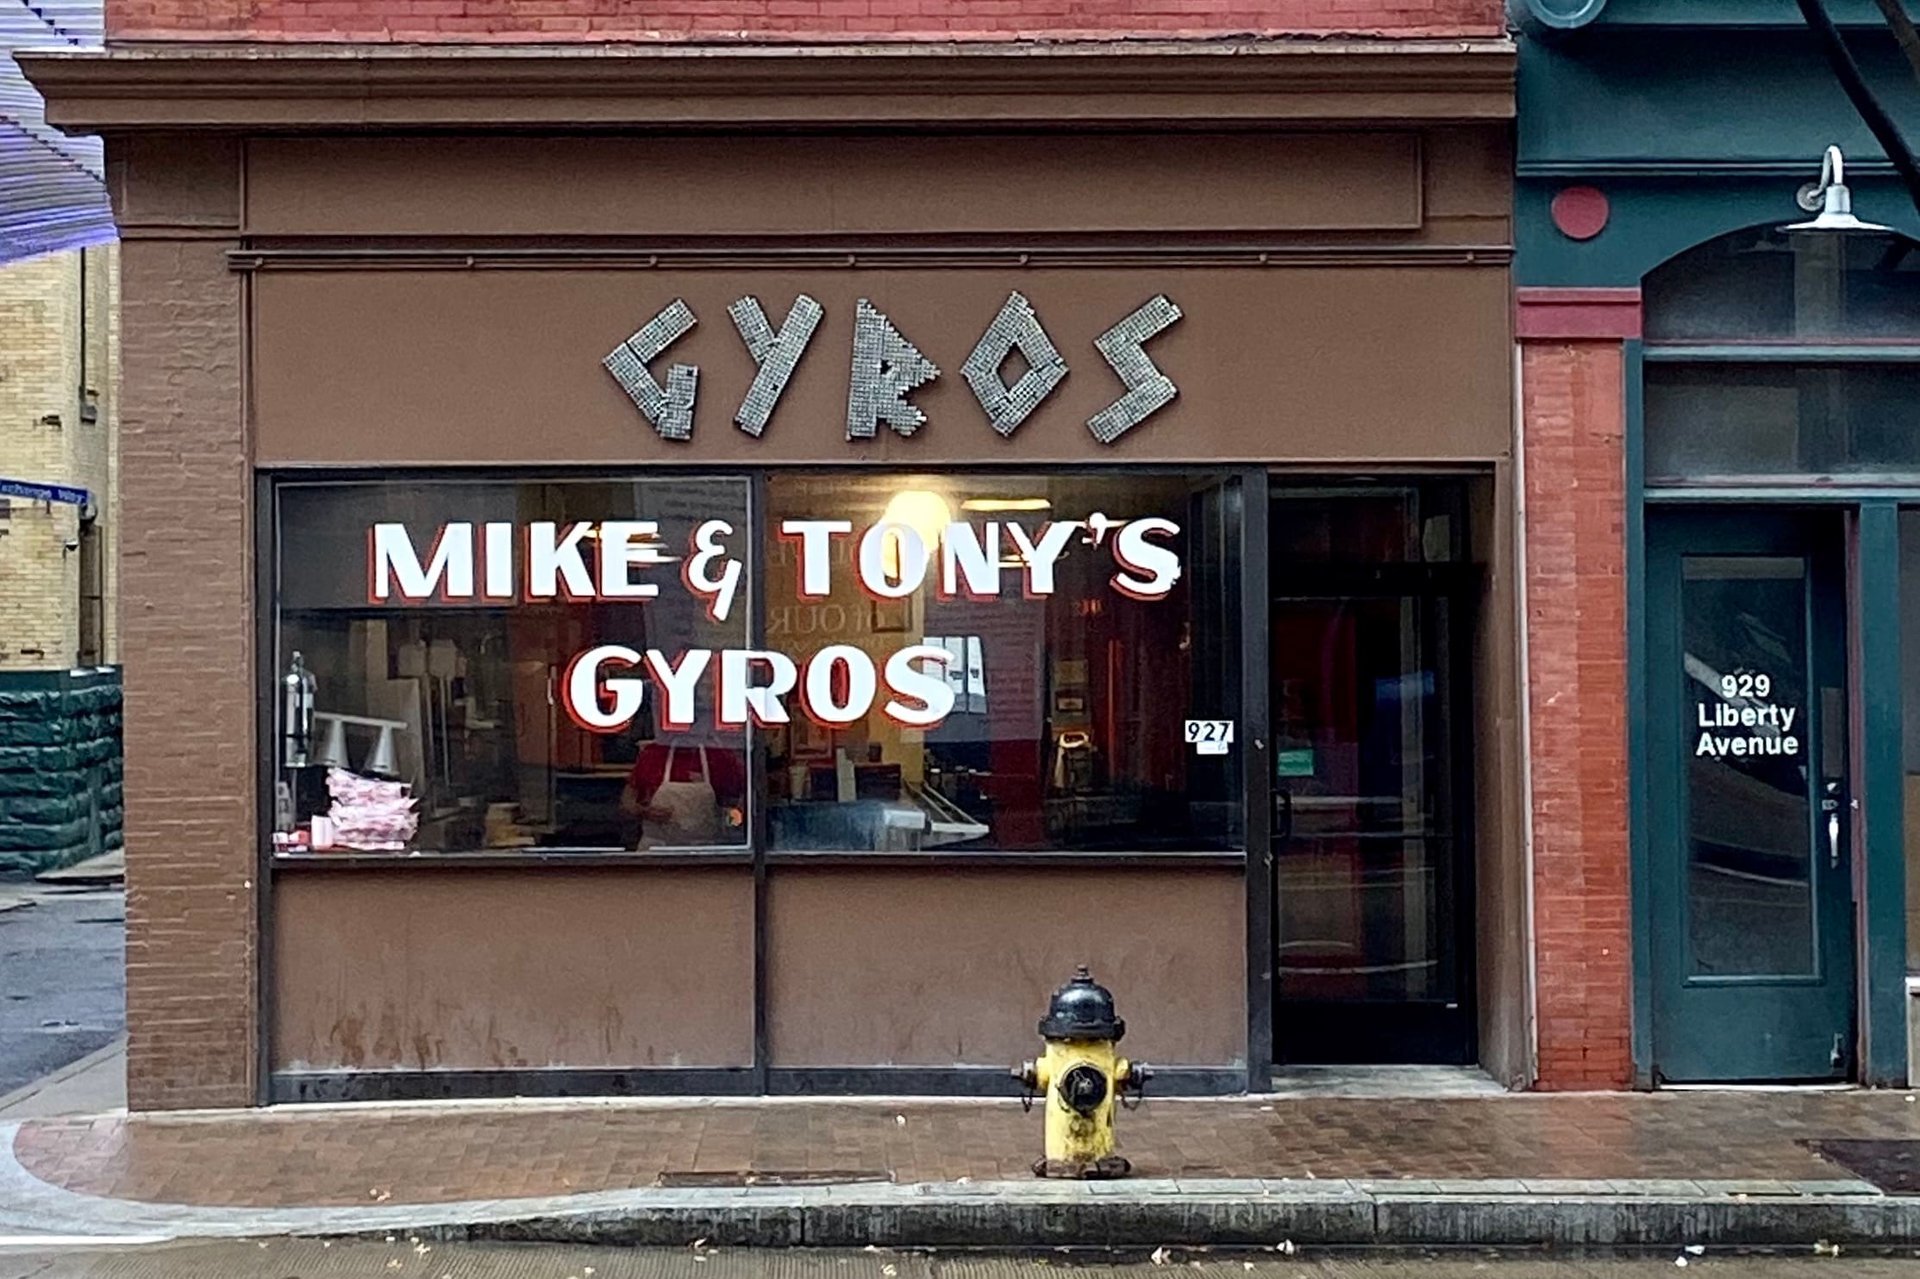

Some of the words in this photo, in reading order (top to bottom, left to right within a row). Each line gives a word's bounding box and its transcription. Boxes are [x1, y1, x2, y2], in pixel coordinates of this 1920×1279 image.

[602, 291, 1183, 443] GYROS
[369, 520, 659, 602] MIKE
[680, 519, 742, 622] &
[777, 514, 1182, 600] TONY'S
[562, 644, 957, 732] GYROS
[1721, 674, 1770, 698] 929
[1188, 722, 1231, 742] 927
[1698, 703, 1796, 732] Liberty
[1696, 732, 1799, 756] Avenue
